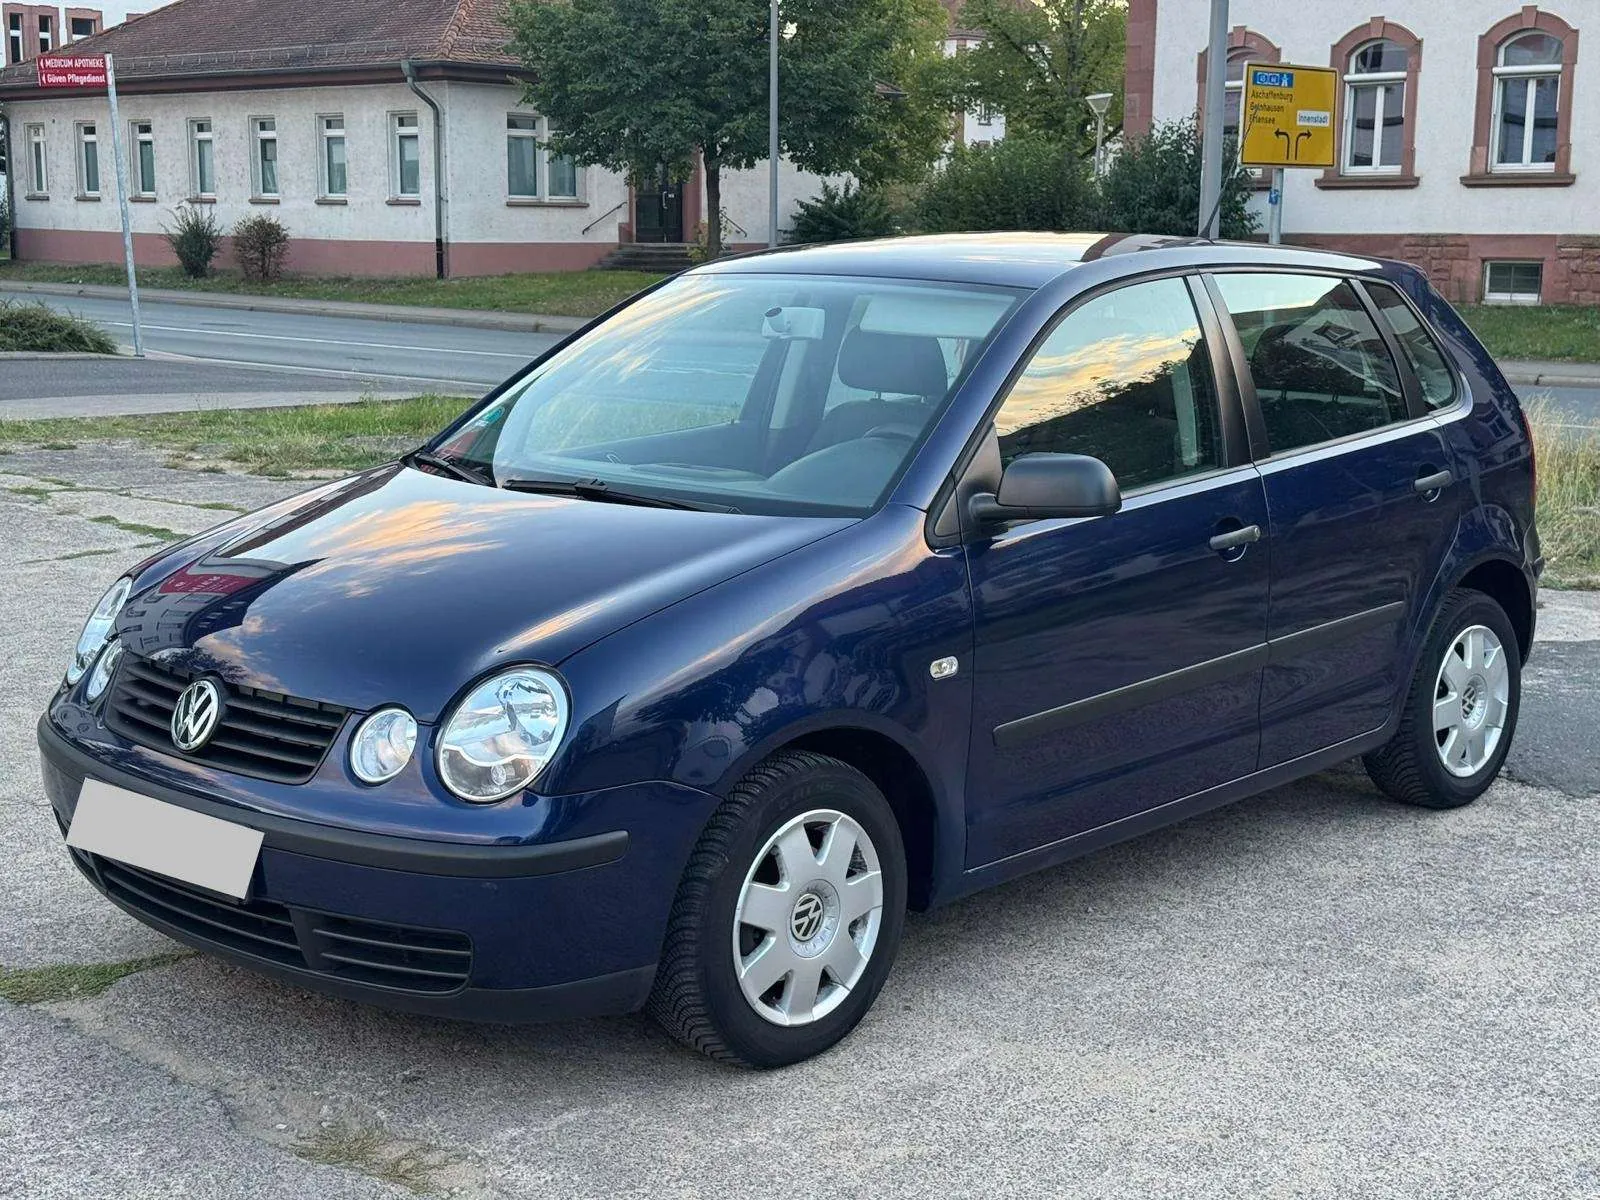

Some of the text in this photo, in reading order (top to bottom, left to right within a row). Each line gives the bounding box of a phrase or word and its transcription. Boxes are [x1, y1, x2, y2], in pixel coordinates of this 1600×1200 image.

[45, 58, 104, 68] MEDICUM APOTHEKE
[47, 73, 106, 85] Güven Pflegedienst
[1250, 89, 1293, 103] Aschaffenburg
[1298, 113, 1328, 124] Innenstadt
